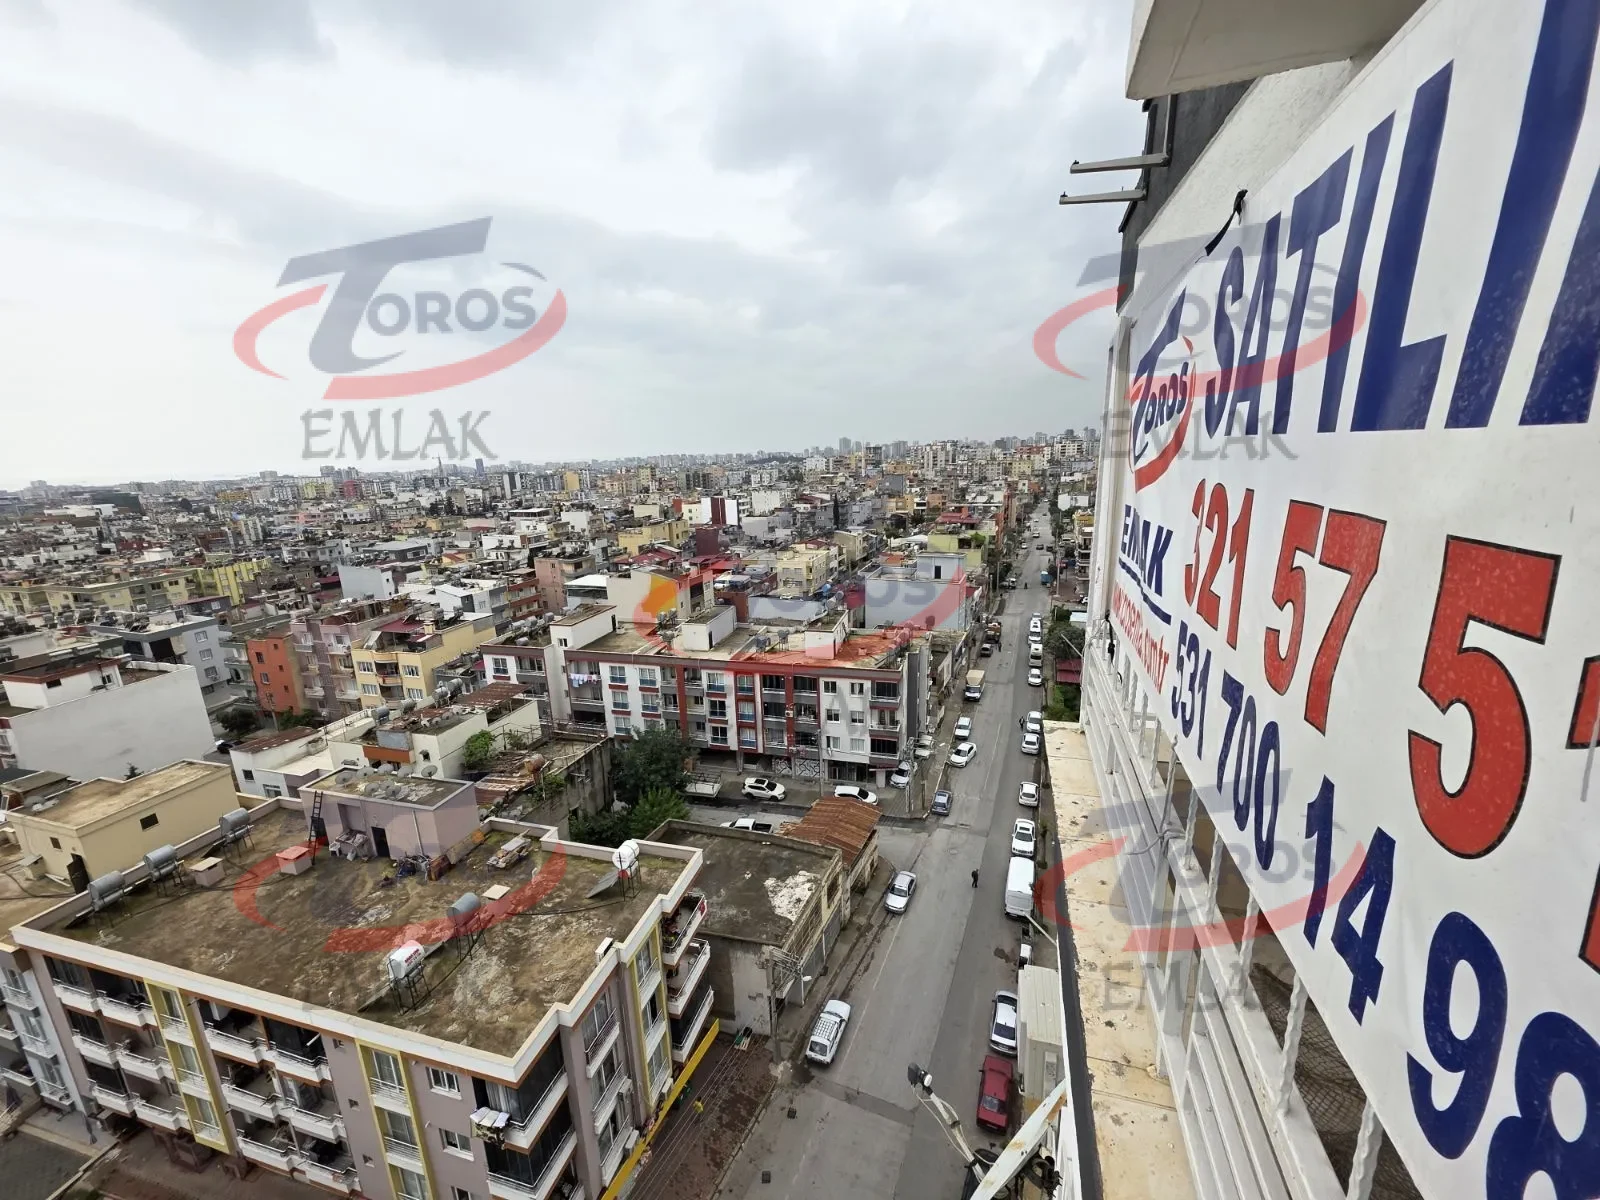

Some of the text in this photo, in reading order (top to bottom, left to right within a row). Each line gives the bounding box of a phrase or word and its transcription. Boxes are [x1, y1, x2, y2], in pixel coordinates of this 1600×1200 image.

[1205, 0, 1600, 439] SATILI
[1133, 286, 1190, 465] TOROS
[1120, 504, 1173, 597] EMAK
[1184, 478, 1254, 651] 321
[1264, 499, 1387, 736] 57
[1171, 620, 1212, 760] 531
[1217, 669, 1280, 870] 700
